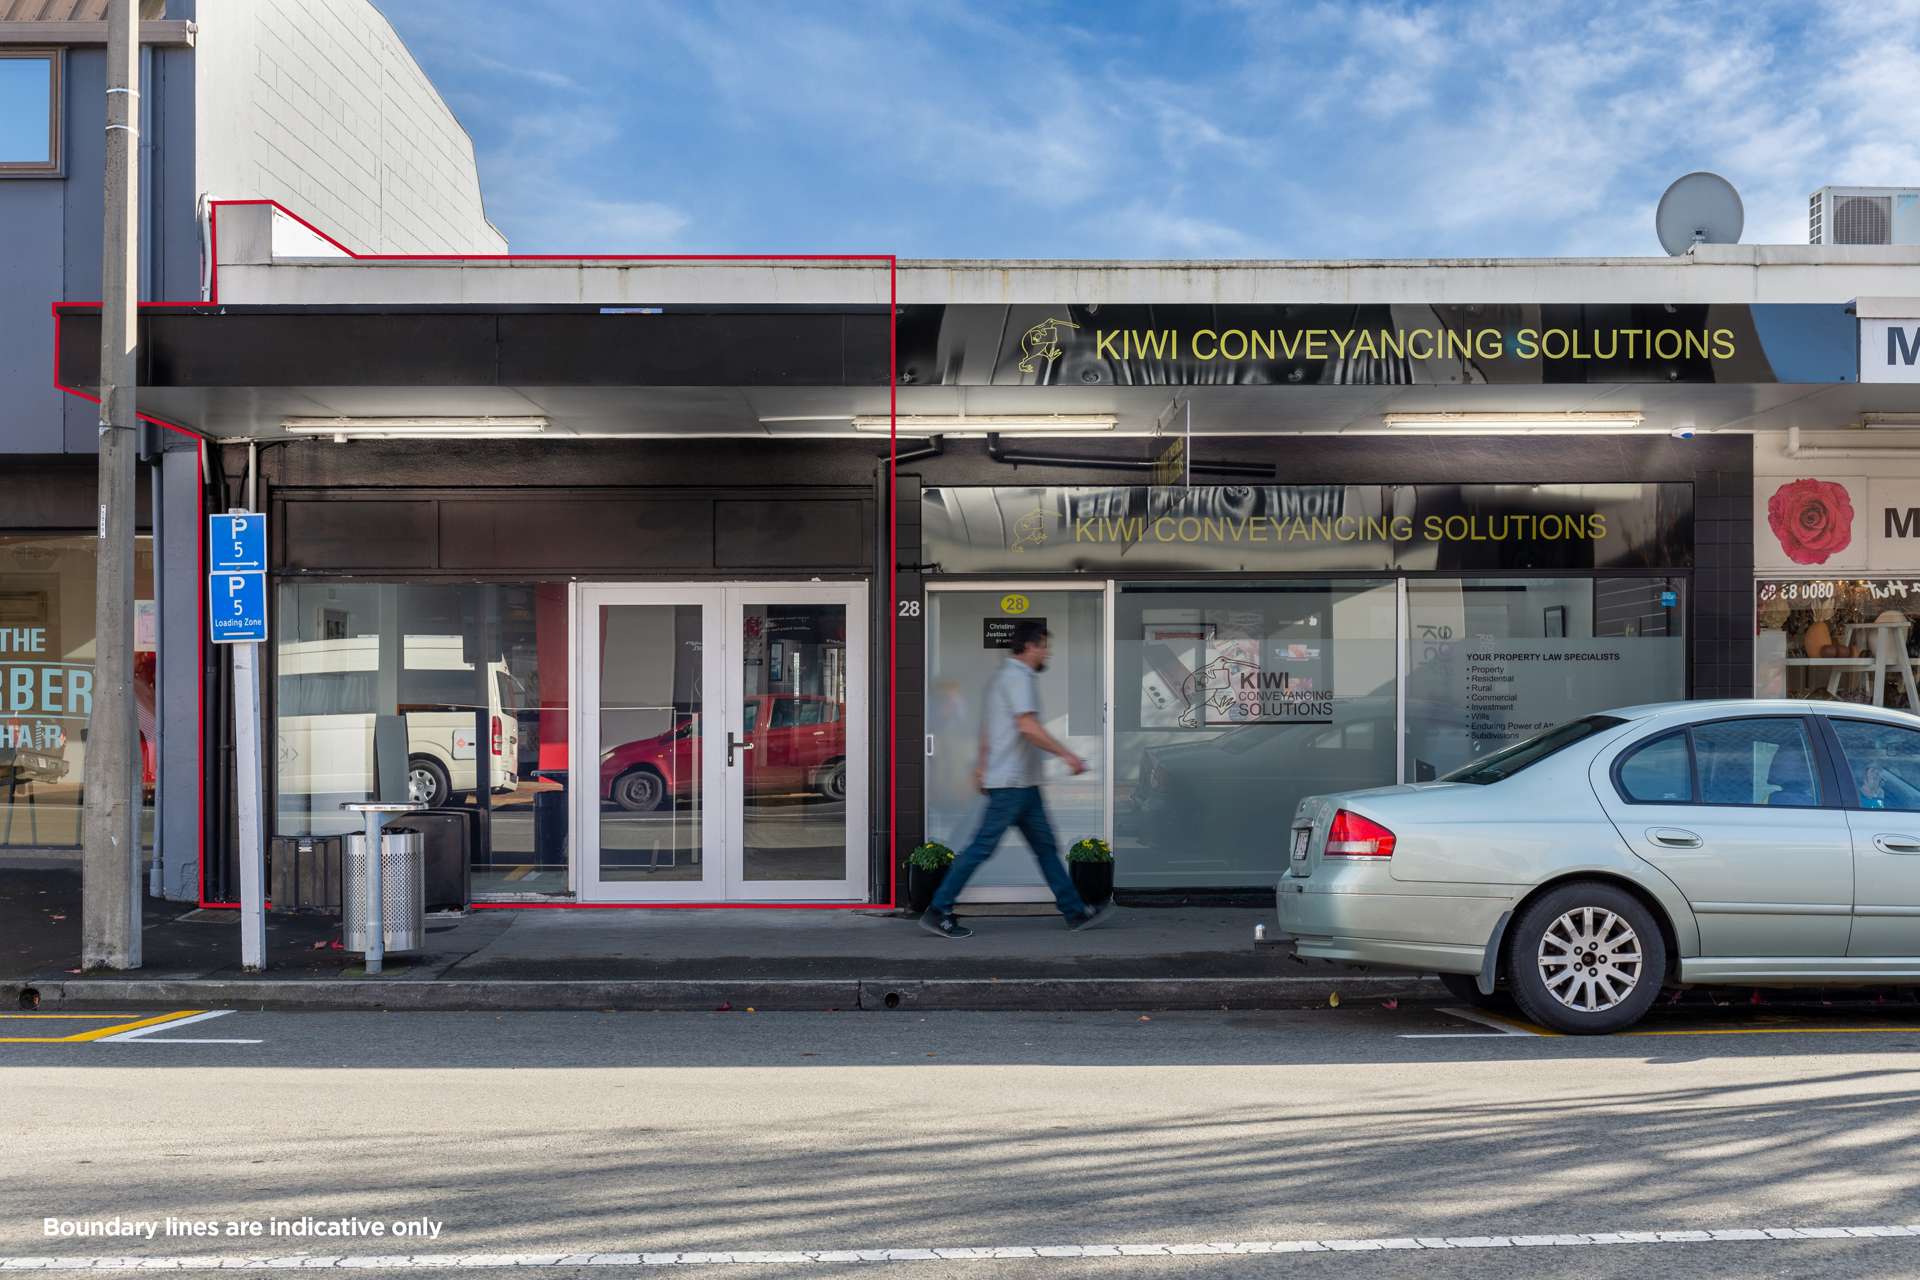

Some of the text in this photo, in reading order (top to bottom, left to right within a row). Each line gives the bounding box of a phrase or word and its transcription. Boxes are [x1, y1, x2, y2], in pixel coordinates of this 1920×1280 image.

[1096, 328, 1736, 360] KIWI CONVEYANCING SOLUTIONS
[231, 518, 248, 540] P
[1075, 514, 1608, 542] KIWI CONVEYANCING SOLUTIONS
[234, 541, 244, 558] 5
[228, 576, 246, 598] P
[233, 599, 244, 616] 5
[898, 600, 920, 617] 28
[1006, 598, 1025, 611] 28
[215, 617, 262, 628] Loading Zone
[0, 628, 46, 652] THE
[1466, 652, 1620, 662] YOUR PROPERTY LAW SPECIALISTS
[1471, 665, 1505, 675] Property
[1240, 672, 1289, 689] KIWI
[1471, 674, 1515, 683] Residential
[0, 667, 94, 714] BER
[1471, 684, 1493, 693] Rural
[1238, 691, 1334, 701] CONVEYANCING
[1471, 693, 1518, 702] Commercial
[1239, 702, 1333, 716] SOLUTIONS
[1471, 703, 1514, 712] Investment
[1471, 713, 1490, 721] Wills
[1471, 722, 1506, 732] Enduring
[1508, 722, 1531, 731] Power
[1534, 722, 1543, 730] of
[1471, 732, 1520, 741] Subdivisions
